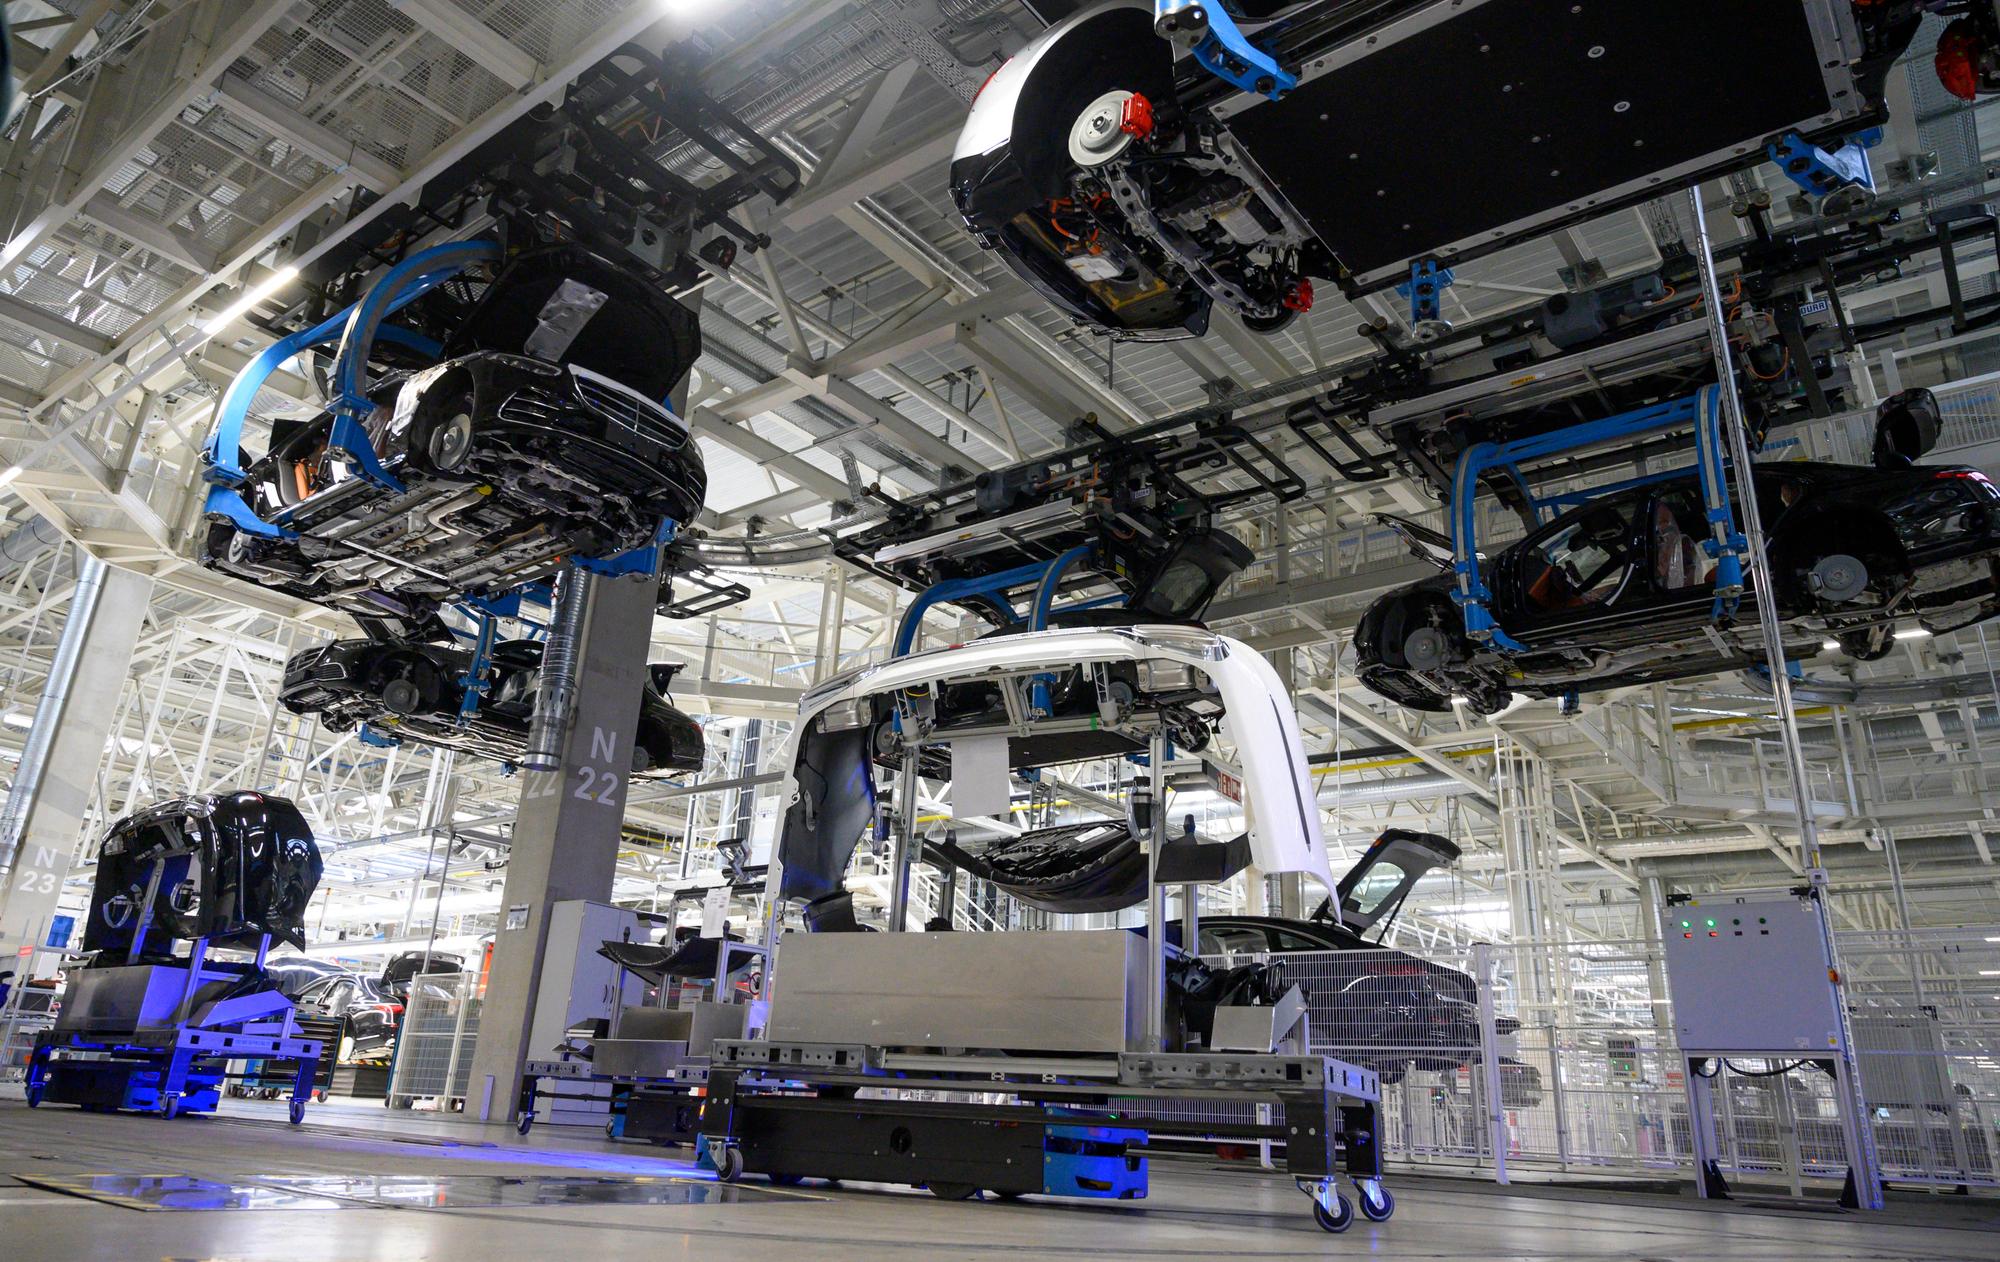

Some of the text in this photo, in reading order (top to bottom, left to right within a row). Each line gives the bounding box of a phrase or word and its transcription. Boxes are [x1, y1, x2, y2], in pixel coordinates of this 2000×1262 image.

[590, 726, 617, 763] N
[574, 766, 618, 806] 22
[34, 846, 58, 869] N
[18, 870, 57, 894] 23
